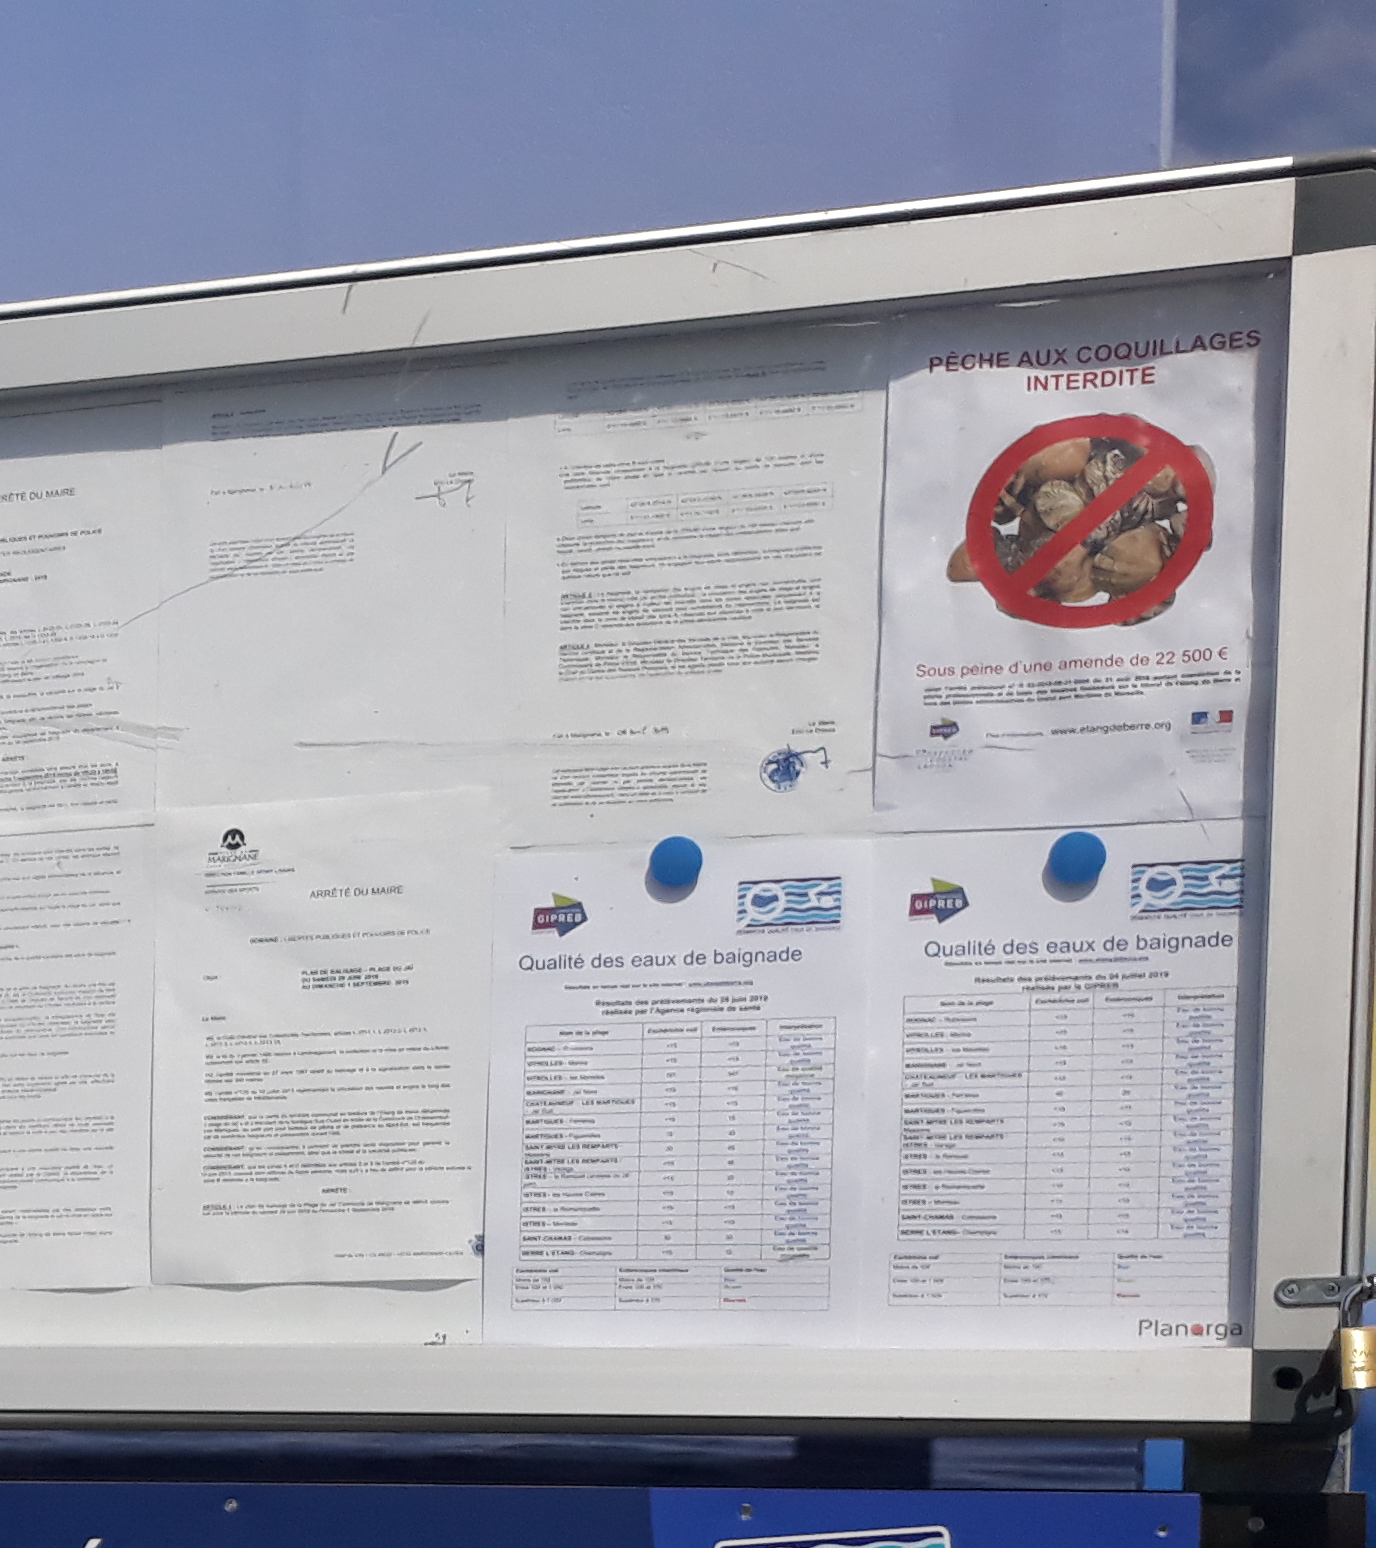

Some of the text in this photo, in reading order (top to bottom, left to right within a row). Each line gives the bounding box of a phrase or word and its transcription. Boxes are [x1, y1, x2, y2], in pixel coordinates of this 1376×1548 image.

[928, 330, 1262, 374] PÊCHE AUX COQUILLAGES
[1027, 366, 1155, 391] INTERDITE
[519, 947, 802, 971] Qualité des eaux de baignade
